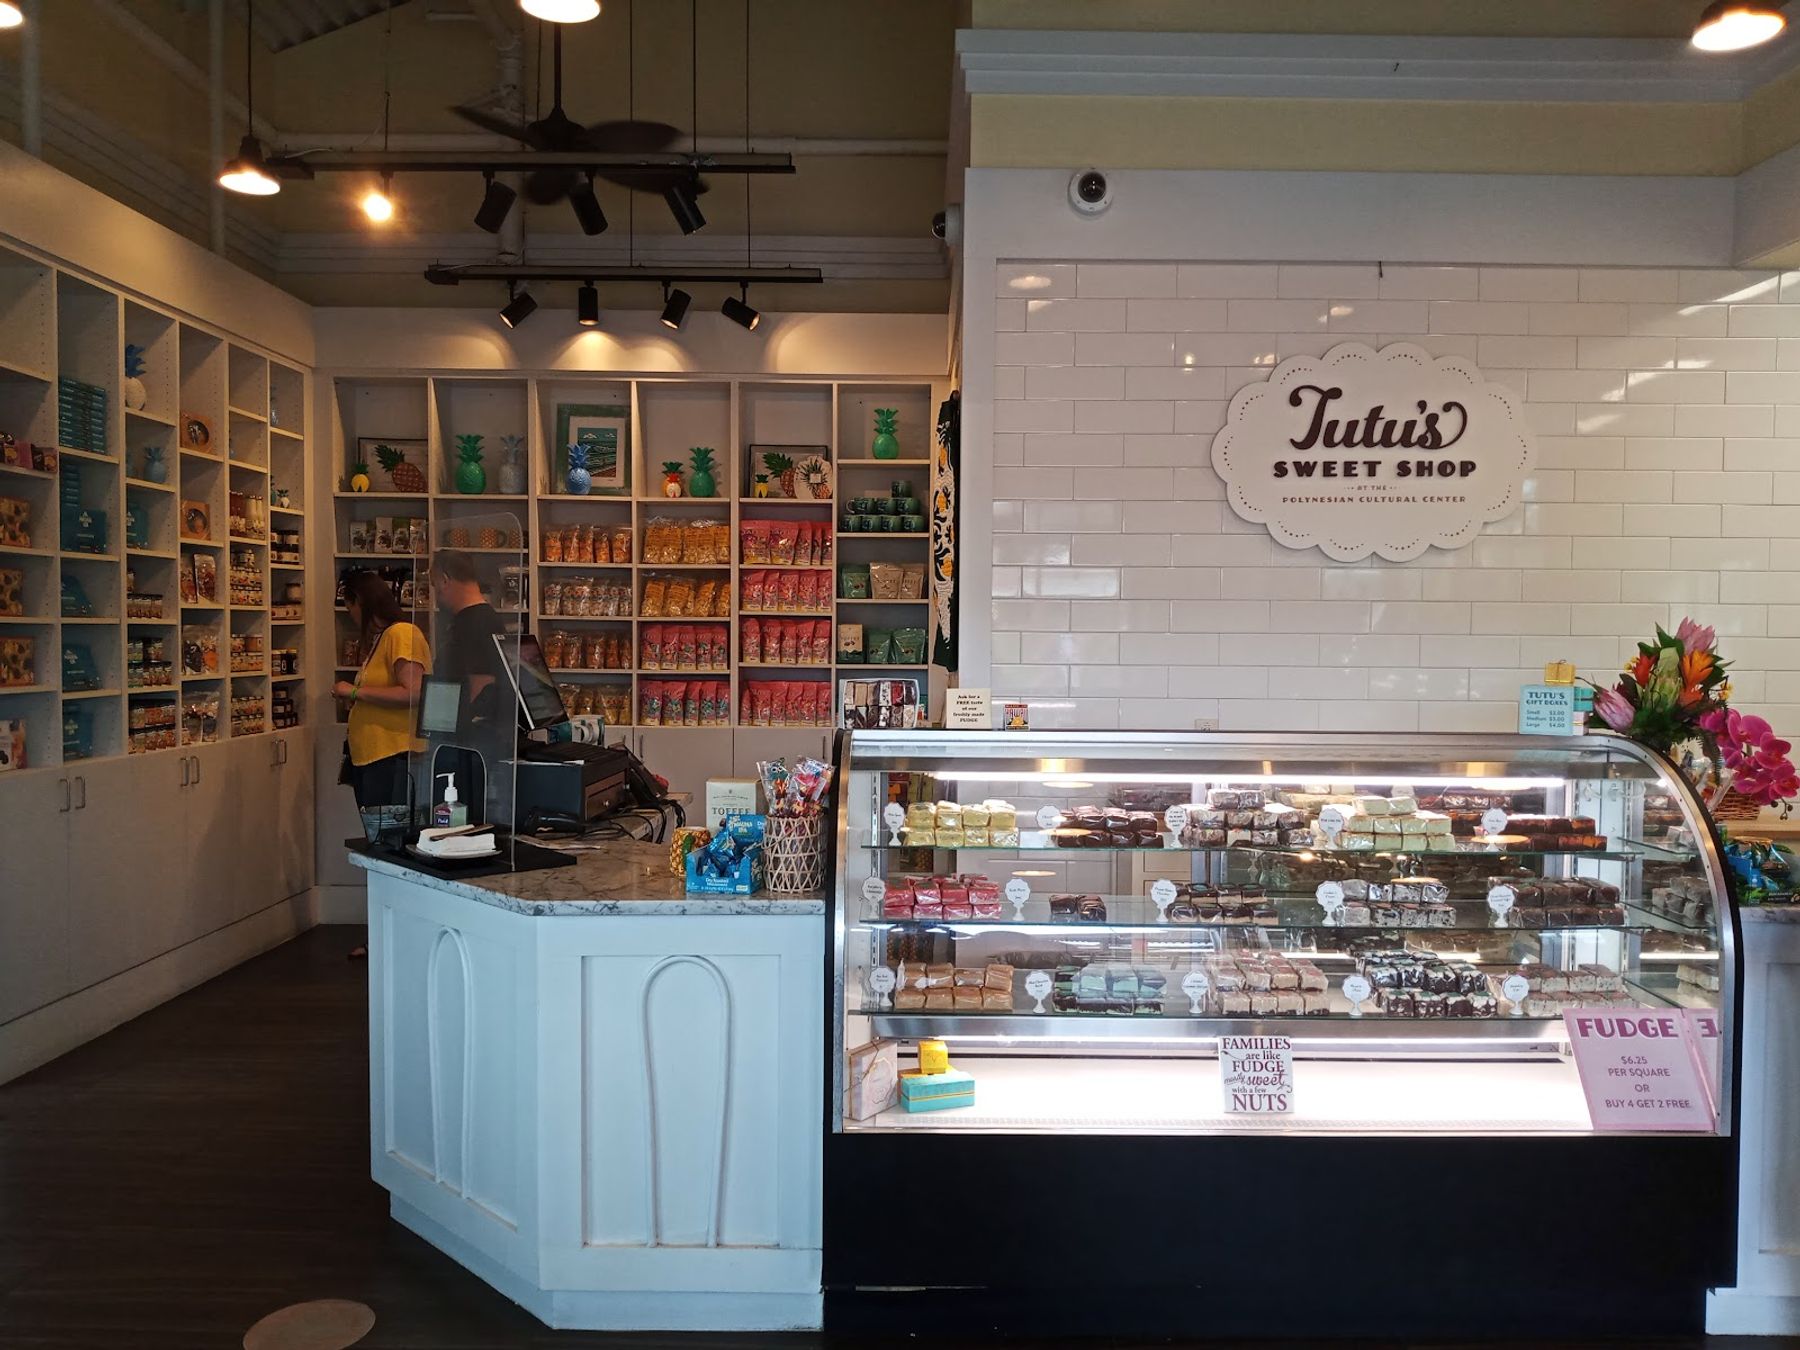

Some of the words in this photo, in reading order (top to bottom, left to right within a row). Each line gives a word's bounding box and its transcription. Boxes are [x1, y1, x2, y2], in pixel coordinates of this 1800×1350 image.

[1289, 384, 1467, 450] Tutu's
[1273, 460, 1382, 478] SWEET
[1396, 460, 1477, 478] SHOP
[1577, 1018, 1679, 1037] FUDGE
[1223, 1038, 1291, 1050] FAMILIES
[1263, 1050, 1280, 1060] like
[1621, 1056, 1648, 1065] $6.25
[1232, 1061, 1285, 1073] FUDGE
[1608, 1068, 1627, 1076] PER
[1629, 1068, 1671, 1078] SQUARE
[1247, 1071, 1287, 1086] sweet
[1634, 1084, 1650, 1092] OR
[1232, 1094, 1287, 1111] NUTS
[1605, 1100, 1625, 1108] BUY
[1628, 1100, 1634, 1108] 4
[1637, 1100, 1655, 1108] GET
[1658, 1100, 1664, 1108] 2
[1666, 1100, 1692, 1108] FREE
